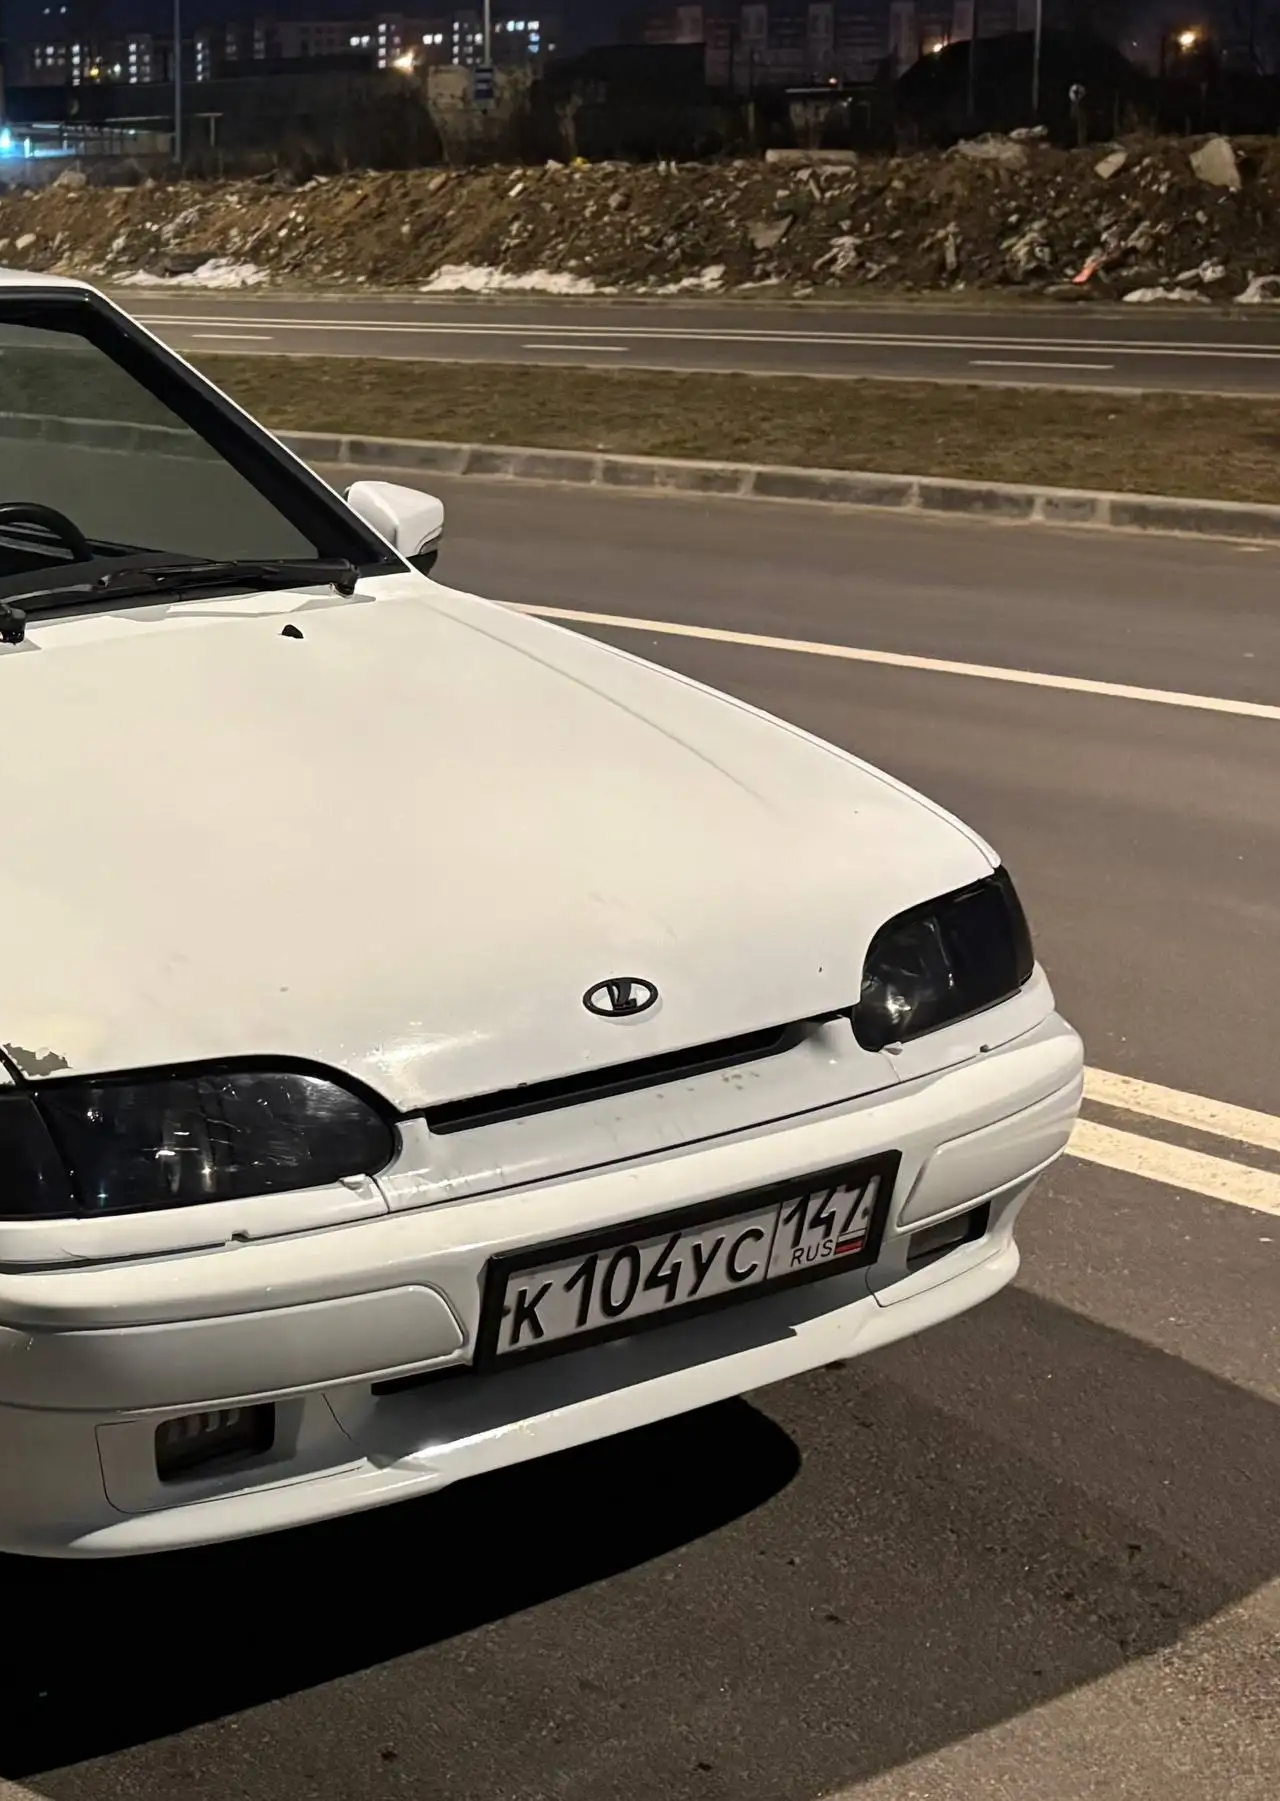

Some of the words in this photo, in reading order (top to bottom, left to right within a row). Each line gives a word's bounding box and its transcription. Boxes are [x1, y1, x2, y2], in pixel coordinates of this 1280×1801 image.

[508, 1226, 765, 1346] К104УС
[783, 1181, 867, 1250] 147
[790, 1239, 834, 1268] RUS
